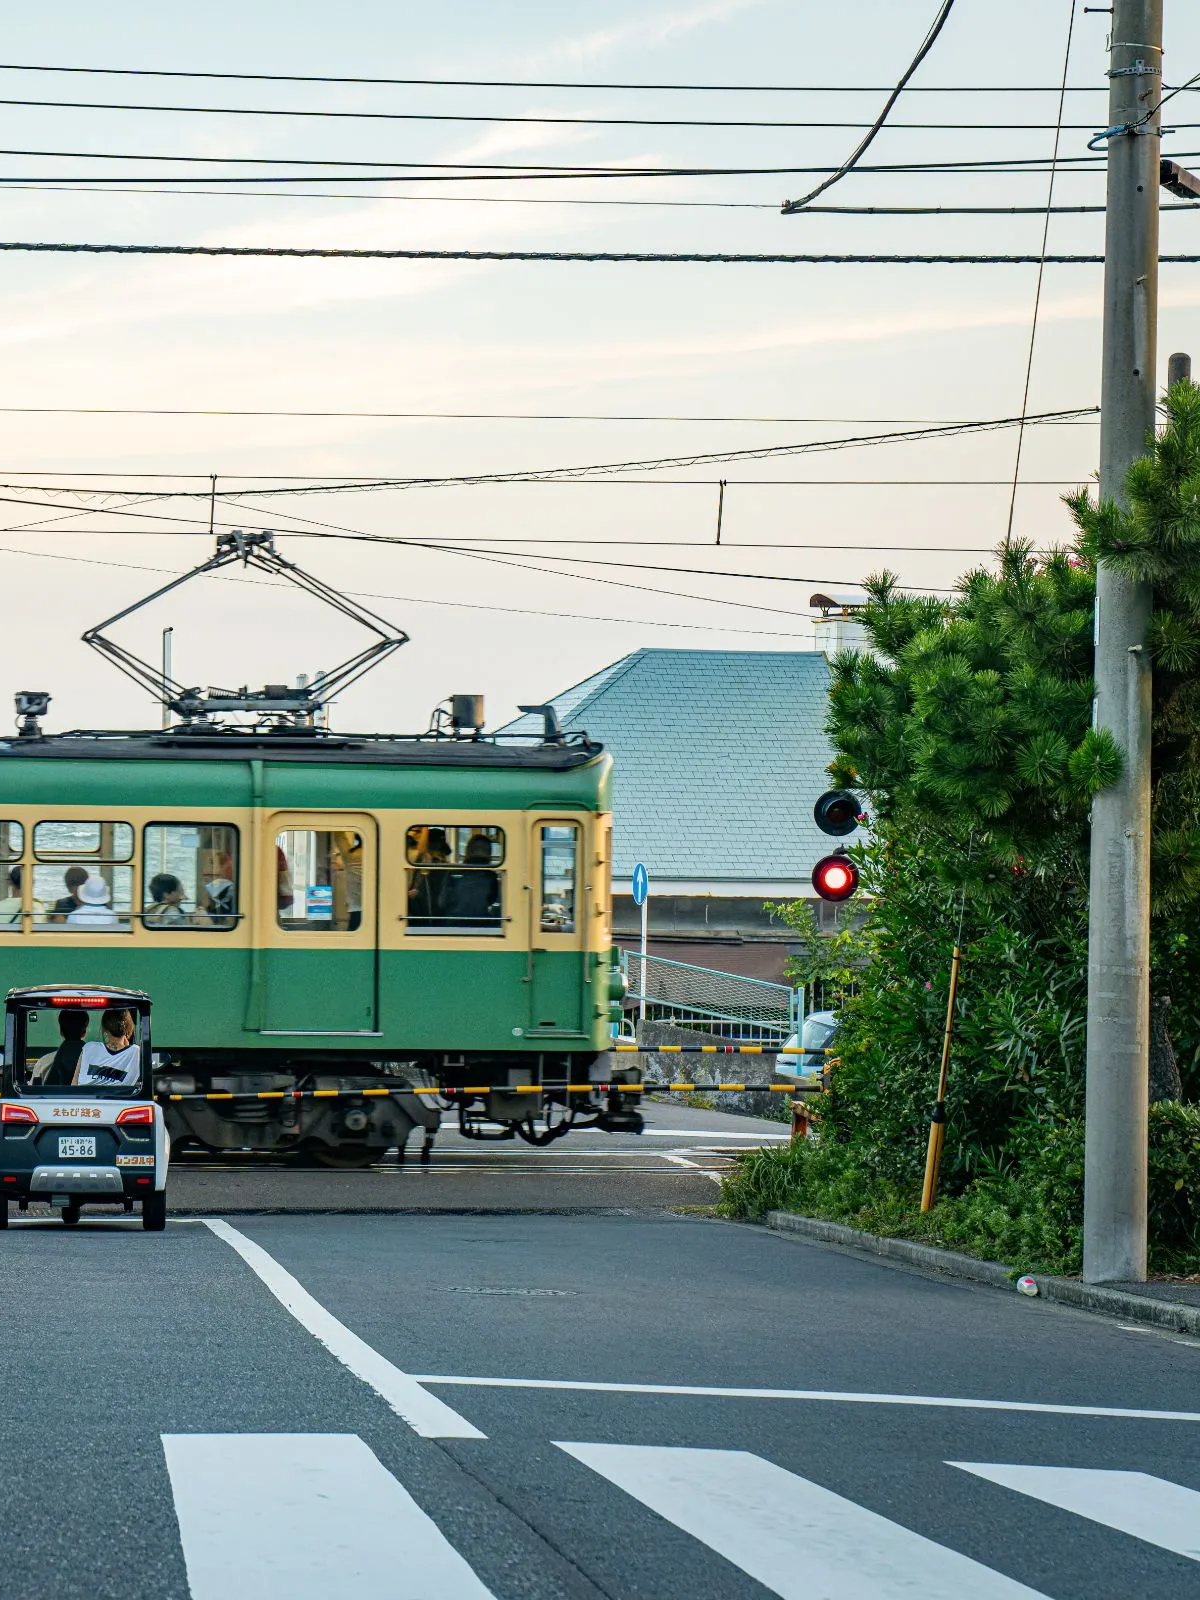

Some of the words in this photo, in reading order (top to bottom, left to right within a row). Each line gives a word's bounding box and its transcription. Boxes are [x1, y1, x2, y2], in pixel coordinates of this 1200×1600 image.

[116, 1156, 154, 1165] レンタル中
